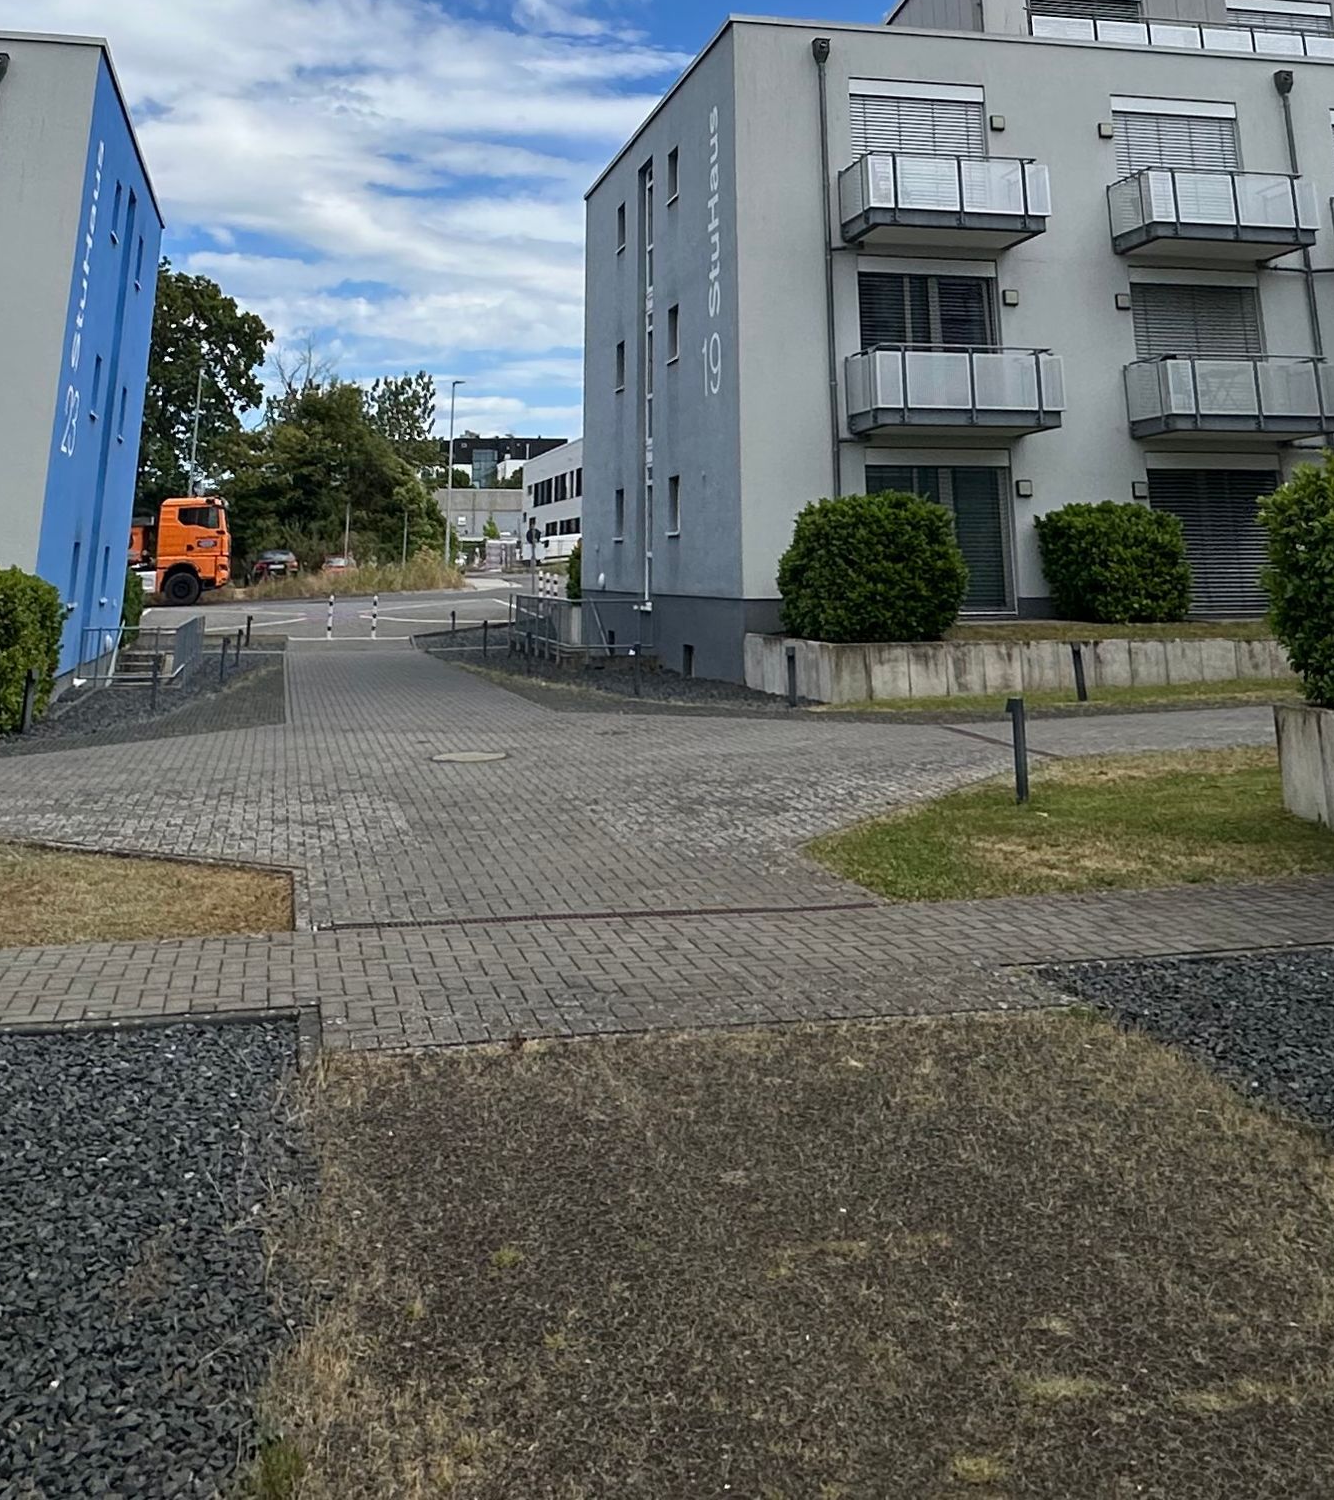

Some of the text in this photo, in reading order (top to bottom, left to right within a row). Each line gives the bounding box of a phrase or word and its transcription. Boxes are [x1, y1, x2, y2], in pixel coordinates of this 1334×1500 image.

[70, 140, 105, 371] StuHaus
[707, 105, 721, 318] StuHaus
[60, 384, 80, 458] 23
[701, 331, 723, 398] 19
